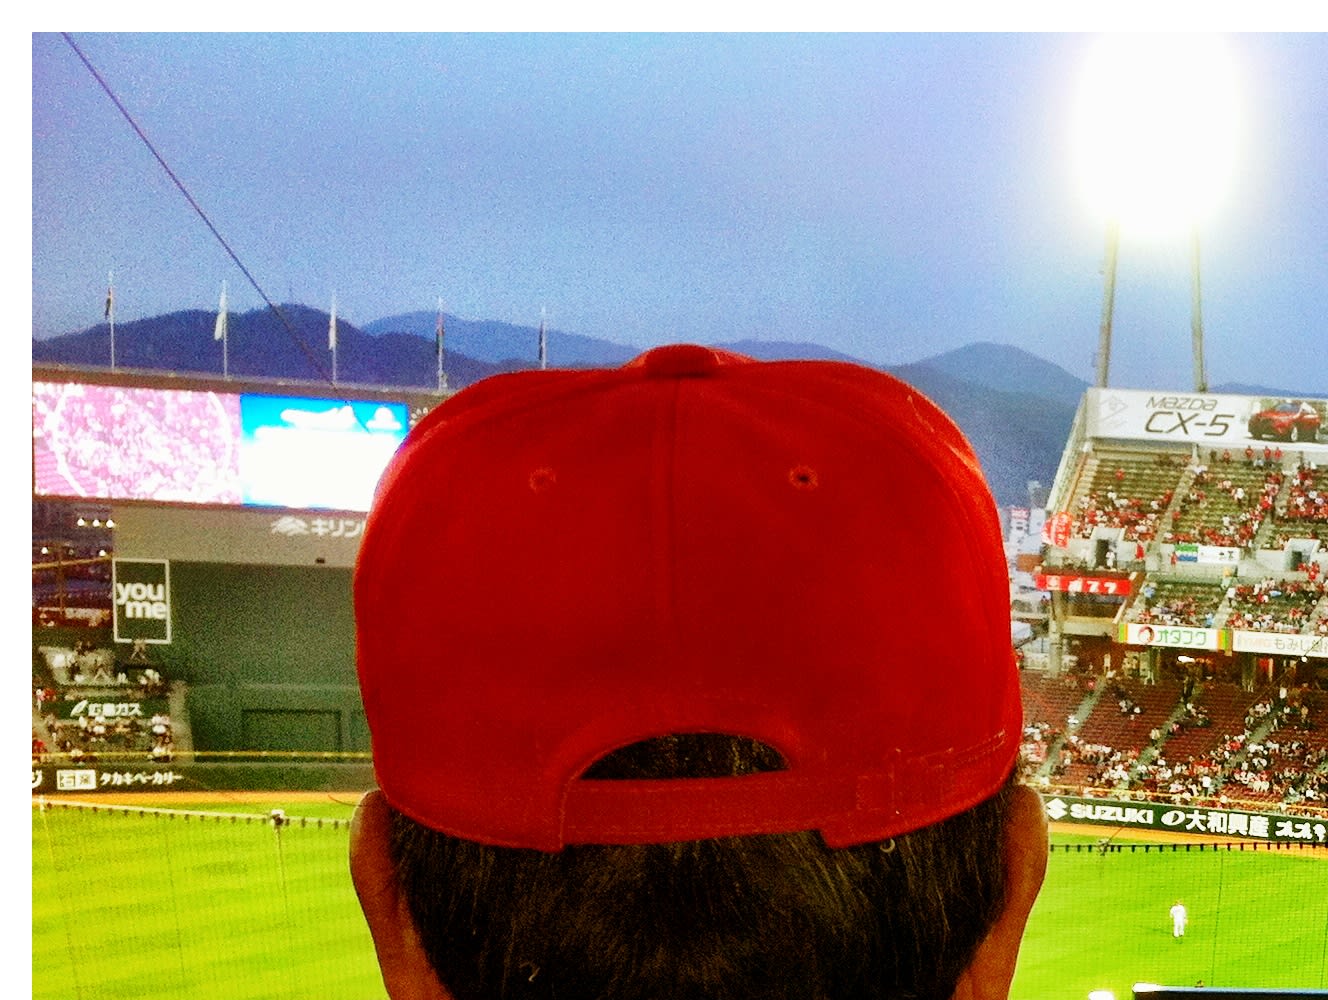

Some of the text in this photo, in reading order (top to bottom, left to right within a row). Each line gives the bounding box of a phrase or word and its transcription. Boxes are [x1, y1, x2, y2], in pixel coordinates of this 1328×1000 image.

[1144, 411, 1235, 437] CX-5
[311, 519, 367, 538] キリン
[116, 582, 164, 605] you
[125, 600, 167, 619] me
[1157, 629, 1208, 646] オタフク
[100, 771, 183, 786] タカキベーカリー
[1070, 803, 1154, 825] SUZUKI
[1185, 809, 1269, 838] 大和興産
